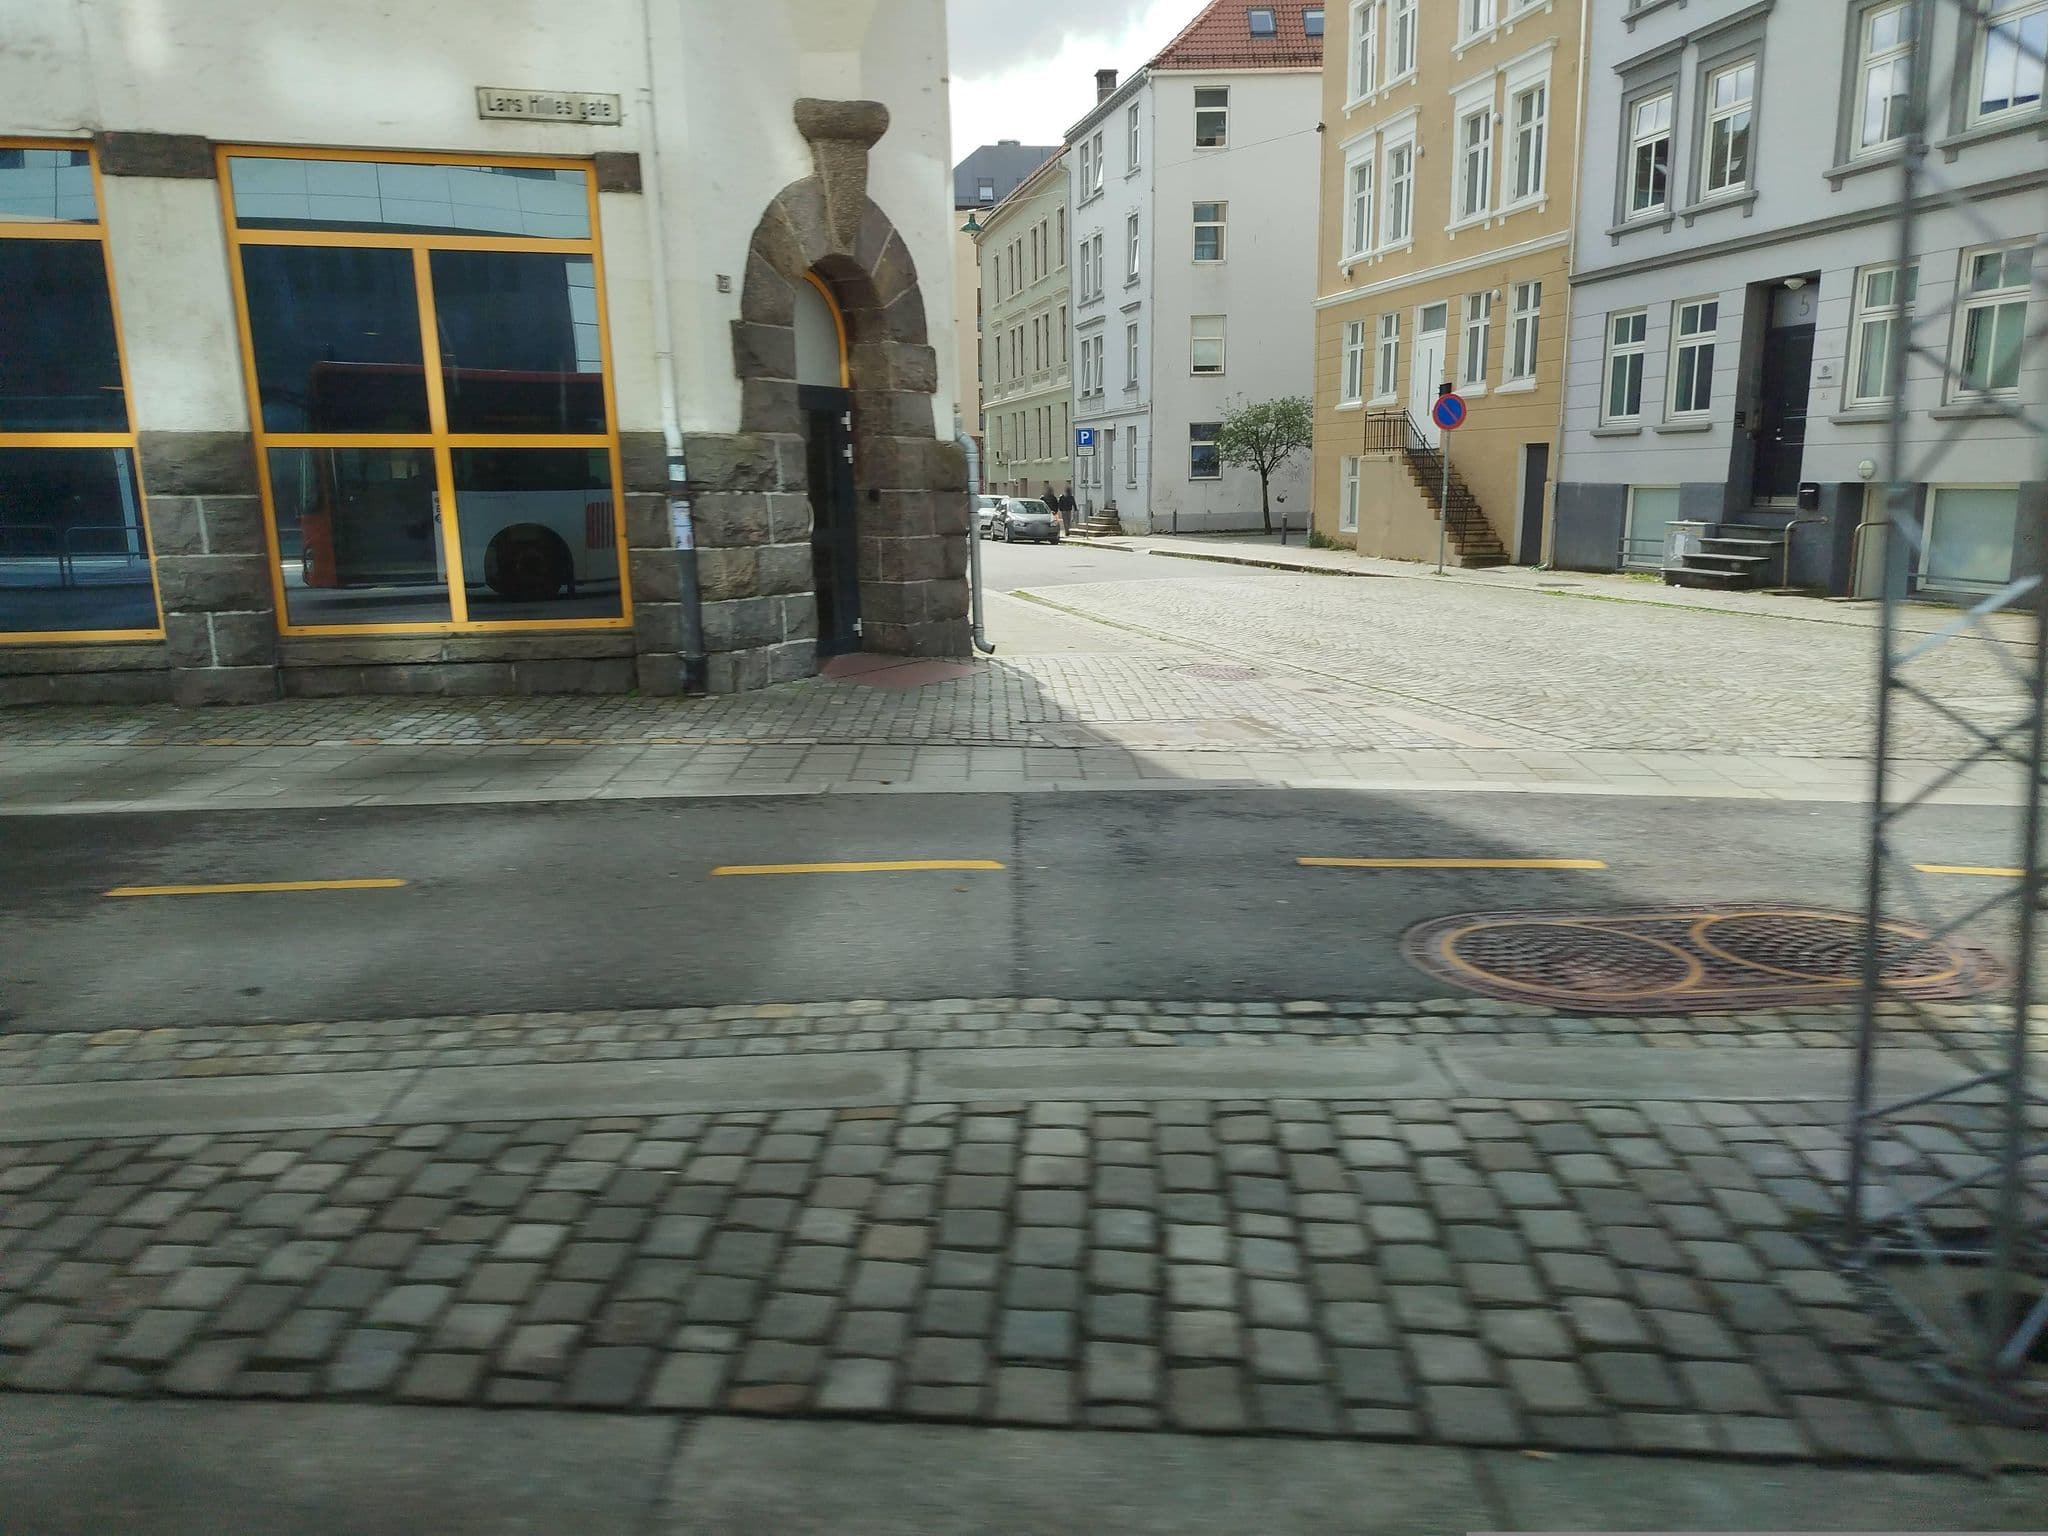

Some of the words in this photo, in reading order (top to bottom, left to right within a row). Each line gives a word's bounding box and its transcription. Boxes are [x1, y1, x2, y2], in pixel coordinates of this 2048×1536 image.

[485, 92, 523, 113] Lars
[528, 94, 573, 115] Hies
[579, 98, 611, 120] gate
[1080, 431, 1090, 444] P
